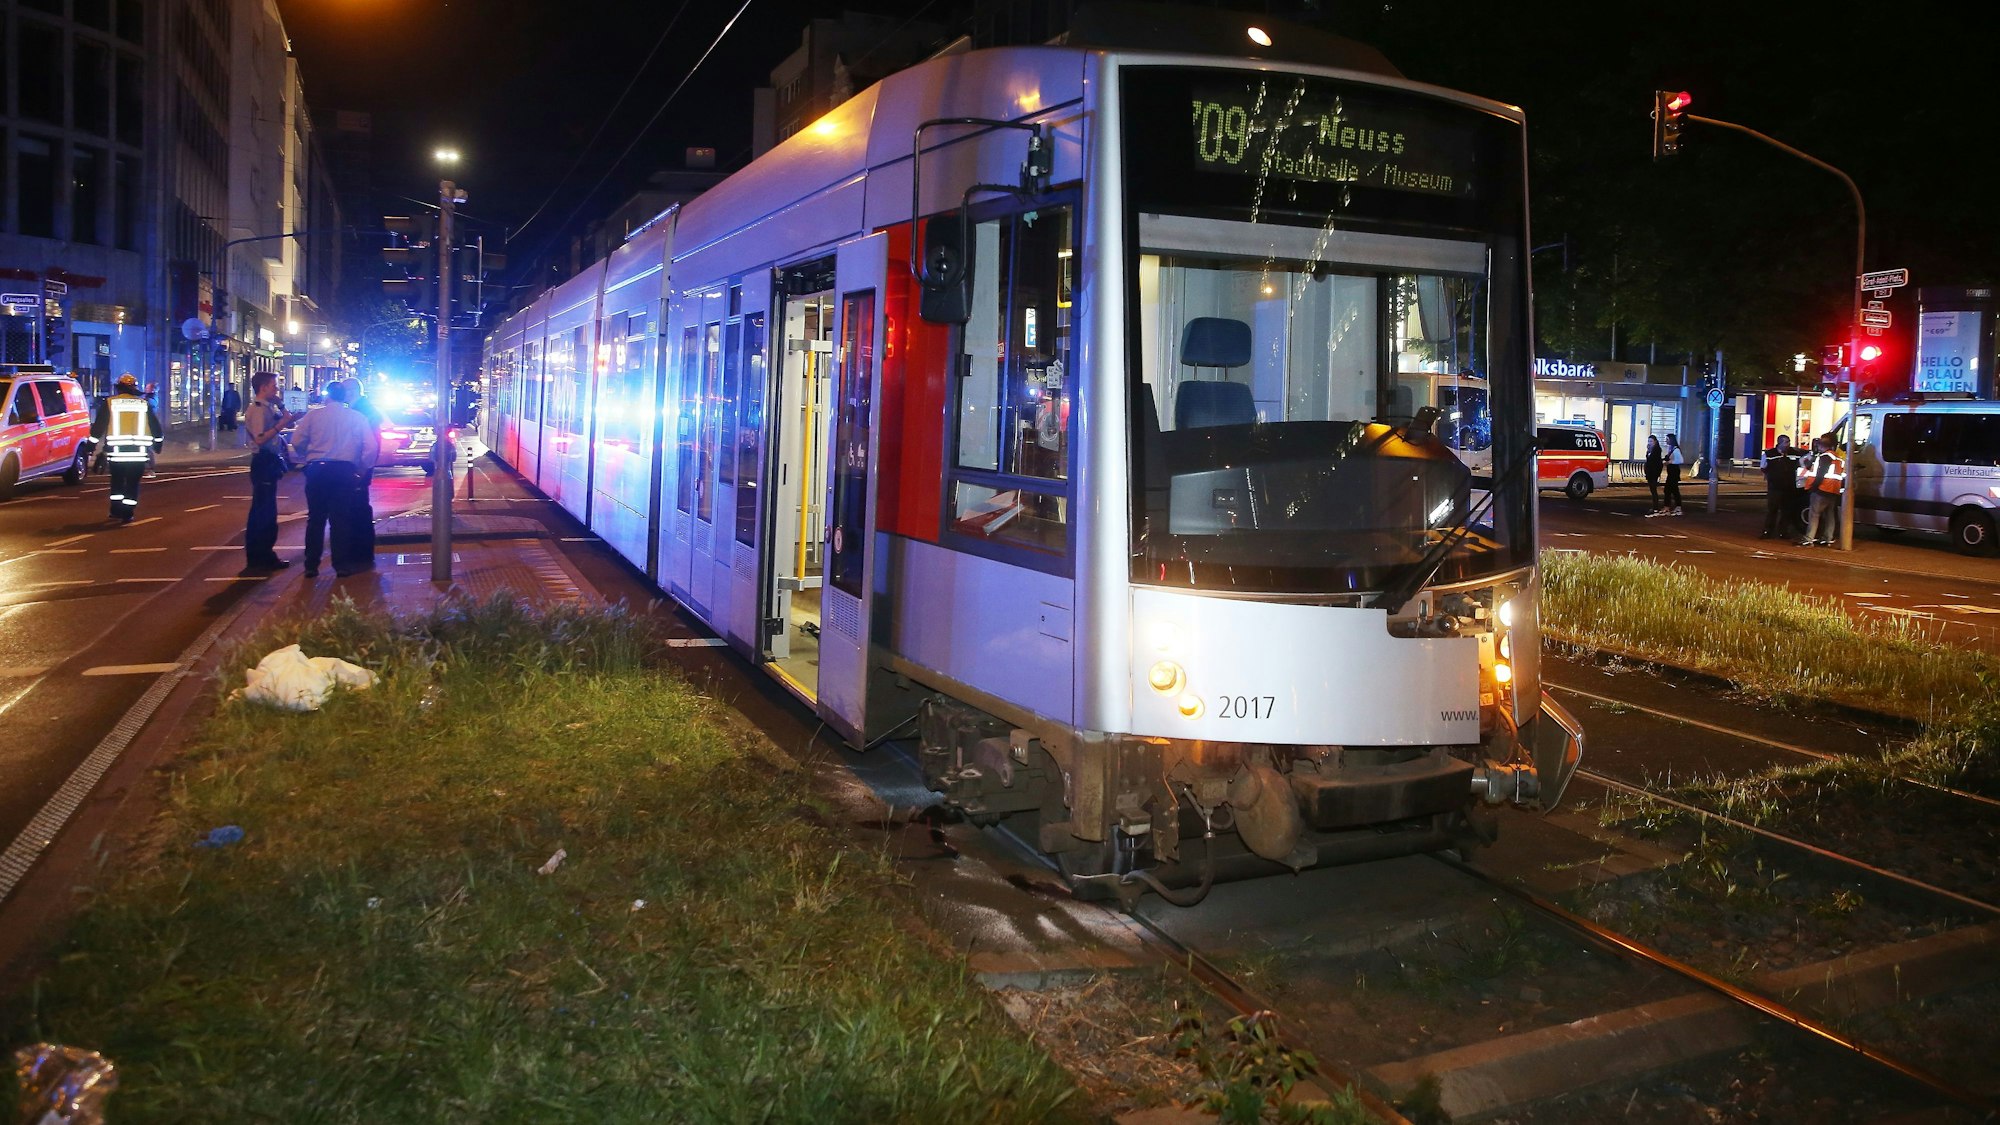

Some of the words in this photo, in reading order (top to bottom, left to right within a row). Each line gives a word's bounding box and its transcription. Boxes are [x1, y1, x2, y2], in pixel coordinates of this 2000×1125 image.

[1317, 114, 1405, 154] Neuss
[1383, 163, 1453, 191] Museum
[1921, 356, 1963, 367] HELLO
[1927, 368, 1963, 379] BLAU
[1583, 438, 1597, 448] 112
[1218, 695, 1276, 719] 2017
[1440, 710, 1479, 722] www.
